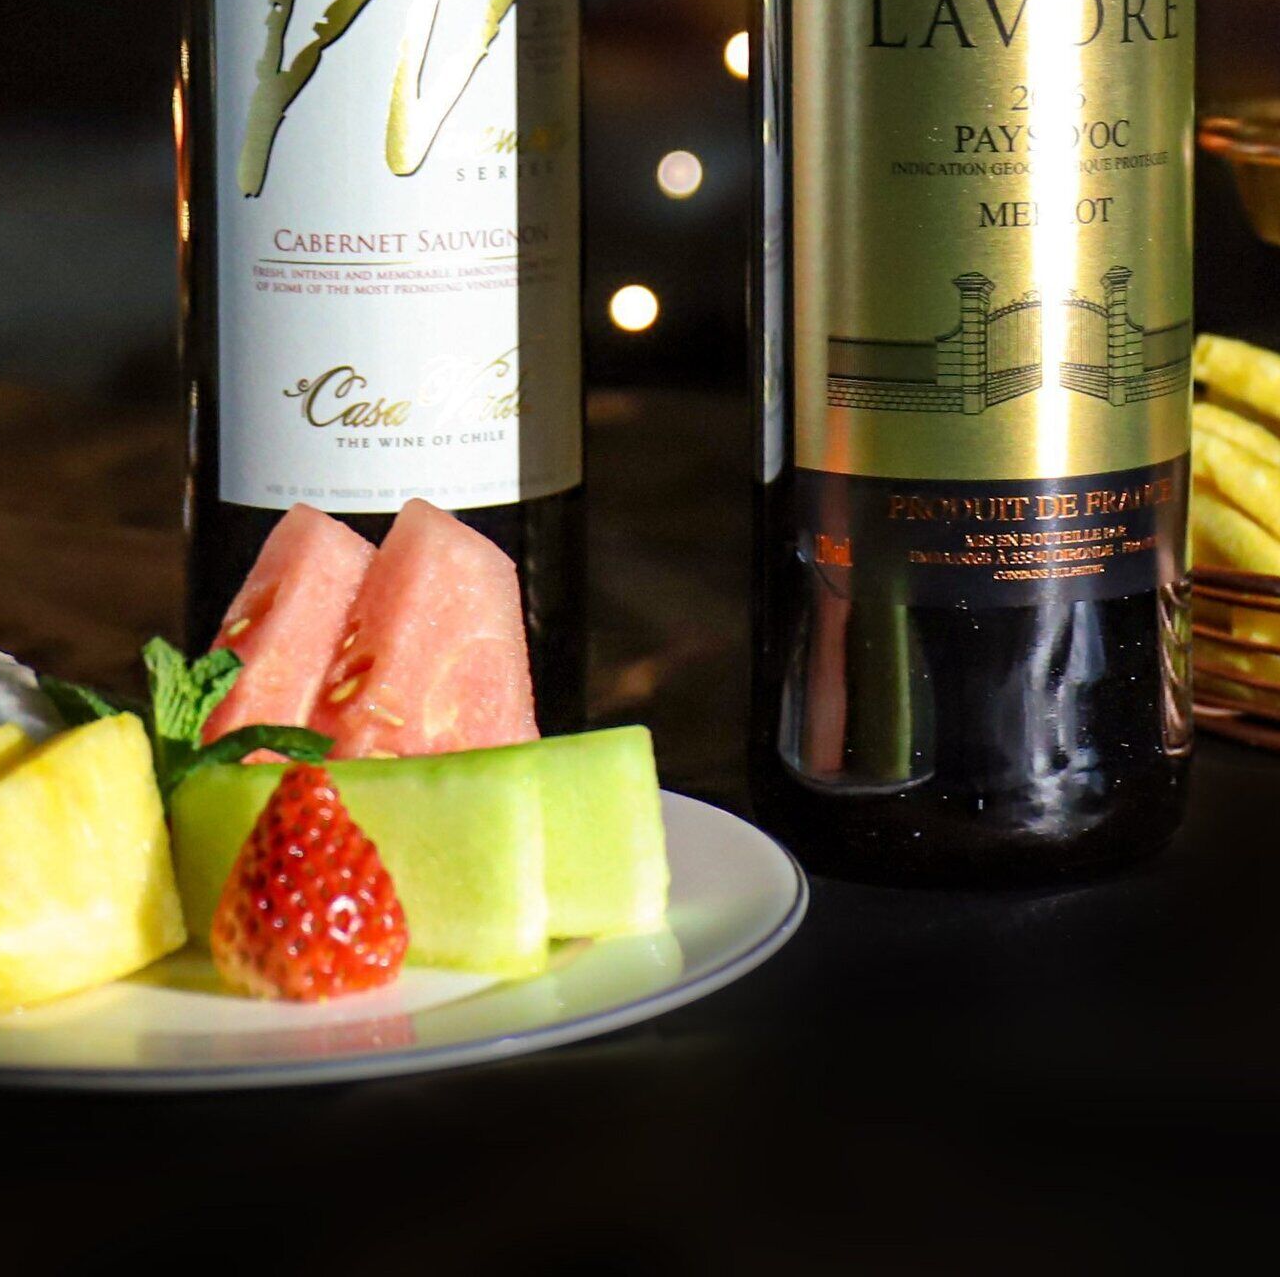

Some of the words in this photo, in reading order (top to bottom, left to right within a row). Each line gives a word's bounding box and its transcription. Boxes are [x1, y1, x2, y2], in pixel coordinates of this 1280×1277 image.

[1010, 85, 1087, 111] 26
[978, 197, 1115, 229] MEOT
[274, 229, 408, 253] CABERNET
[418, 227, 549, 252] SAUVIGNON
[255, 281, 270, 292] OF
[306, 283, 322, 295] OF
[325, 284, 350, 295] THE
[354, 284, 390, 296] MOST
[345, 271, 373, 281] AND
[283, 365, 412, 428] Casa
[336, 437, 370, 449] THE
[379, 436, 425, 449] WINE
[432, 434, 452, 447] OF
[460, 429, 506, 445] CHILE
[1035, 493, 1079, 521] DE
[1020, 527, 1101, 547] BOUTEILLE
